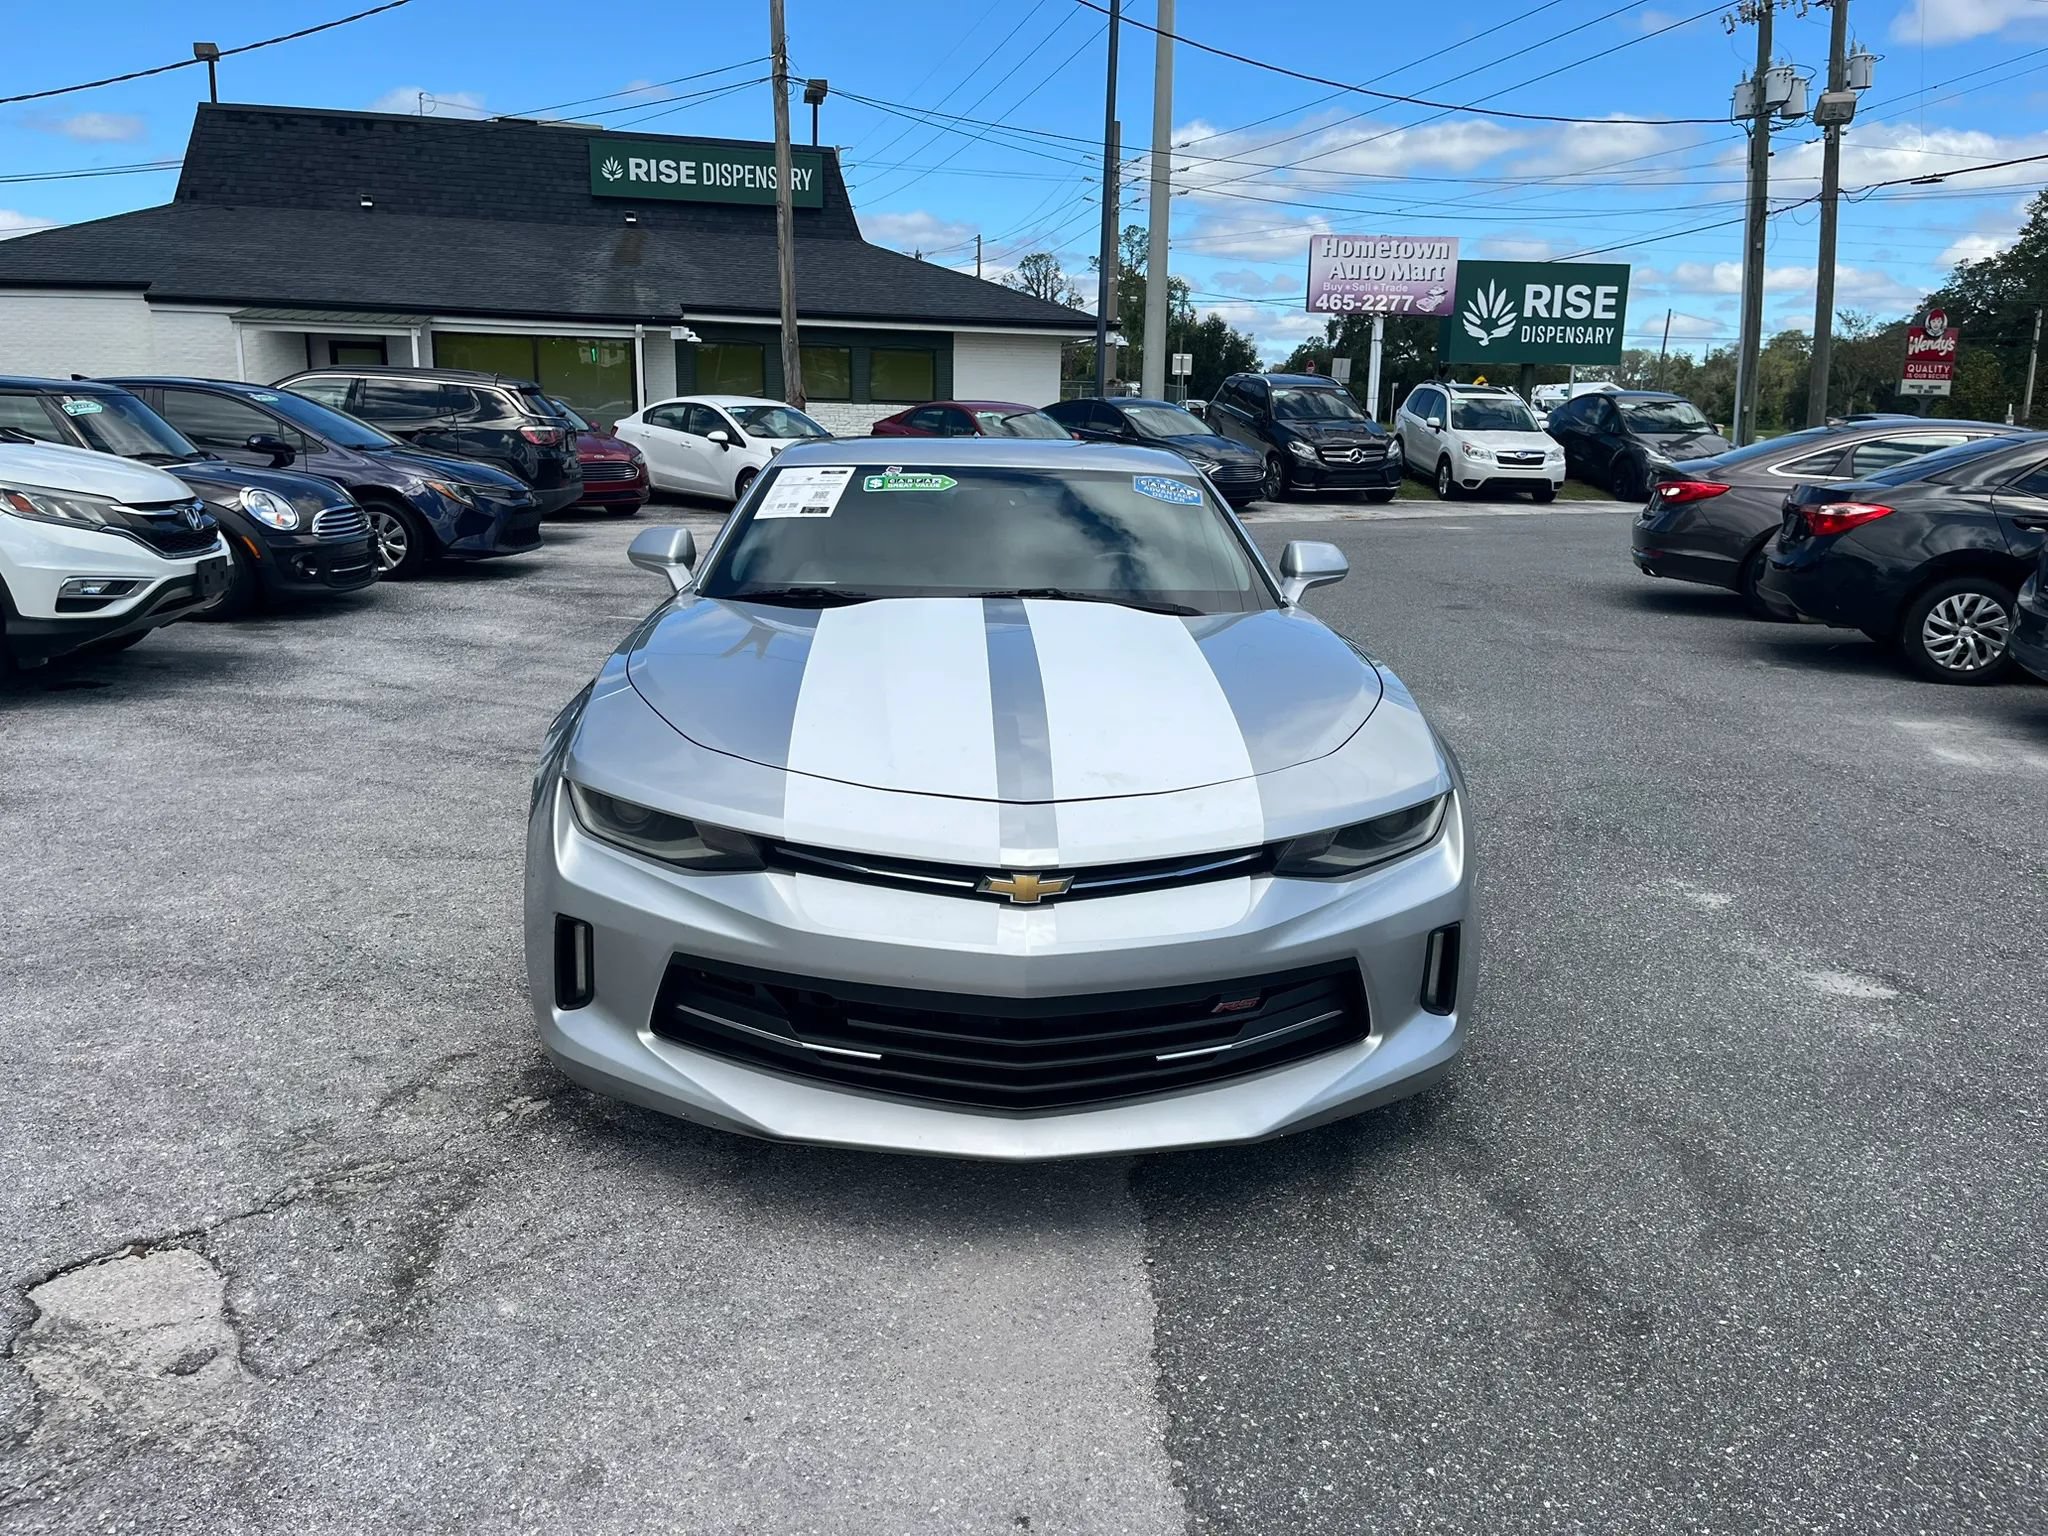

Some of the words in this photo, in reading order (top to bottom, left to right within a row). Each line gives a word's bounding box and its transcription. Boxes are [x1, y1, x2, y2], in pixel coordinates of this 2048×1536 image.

[629, 157, 696, 184] RISE
[703, 162, 813, 191] DISPENSRY
[1321, 238, 1450, 260] Hometown
[1329, 261, 1386, 281] Auto
[1389, 263, 1445, 282] Mart
[1323, 282, 1343, 293] Buy
[1352, 283, 1372, 293] Sell
[1380, 283, 1408, 293] Trade
[1315, 294, 1414, 312] 465-2277
[1523, 284, 1619, 320] RISE
[1521, 325, 1615, 345] DISPENSARY
[1908, 334, 1955, 356] Wendy's
[1907, 364, 1950, 373] QUALITY
